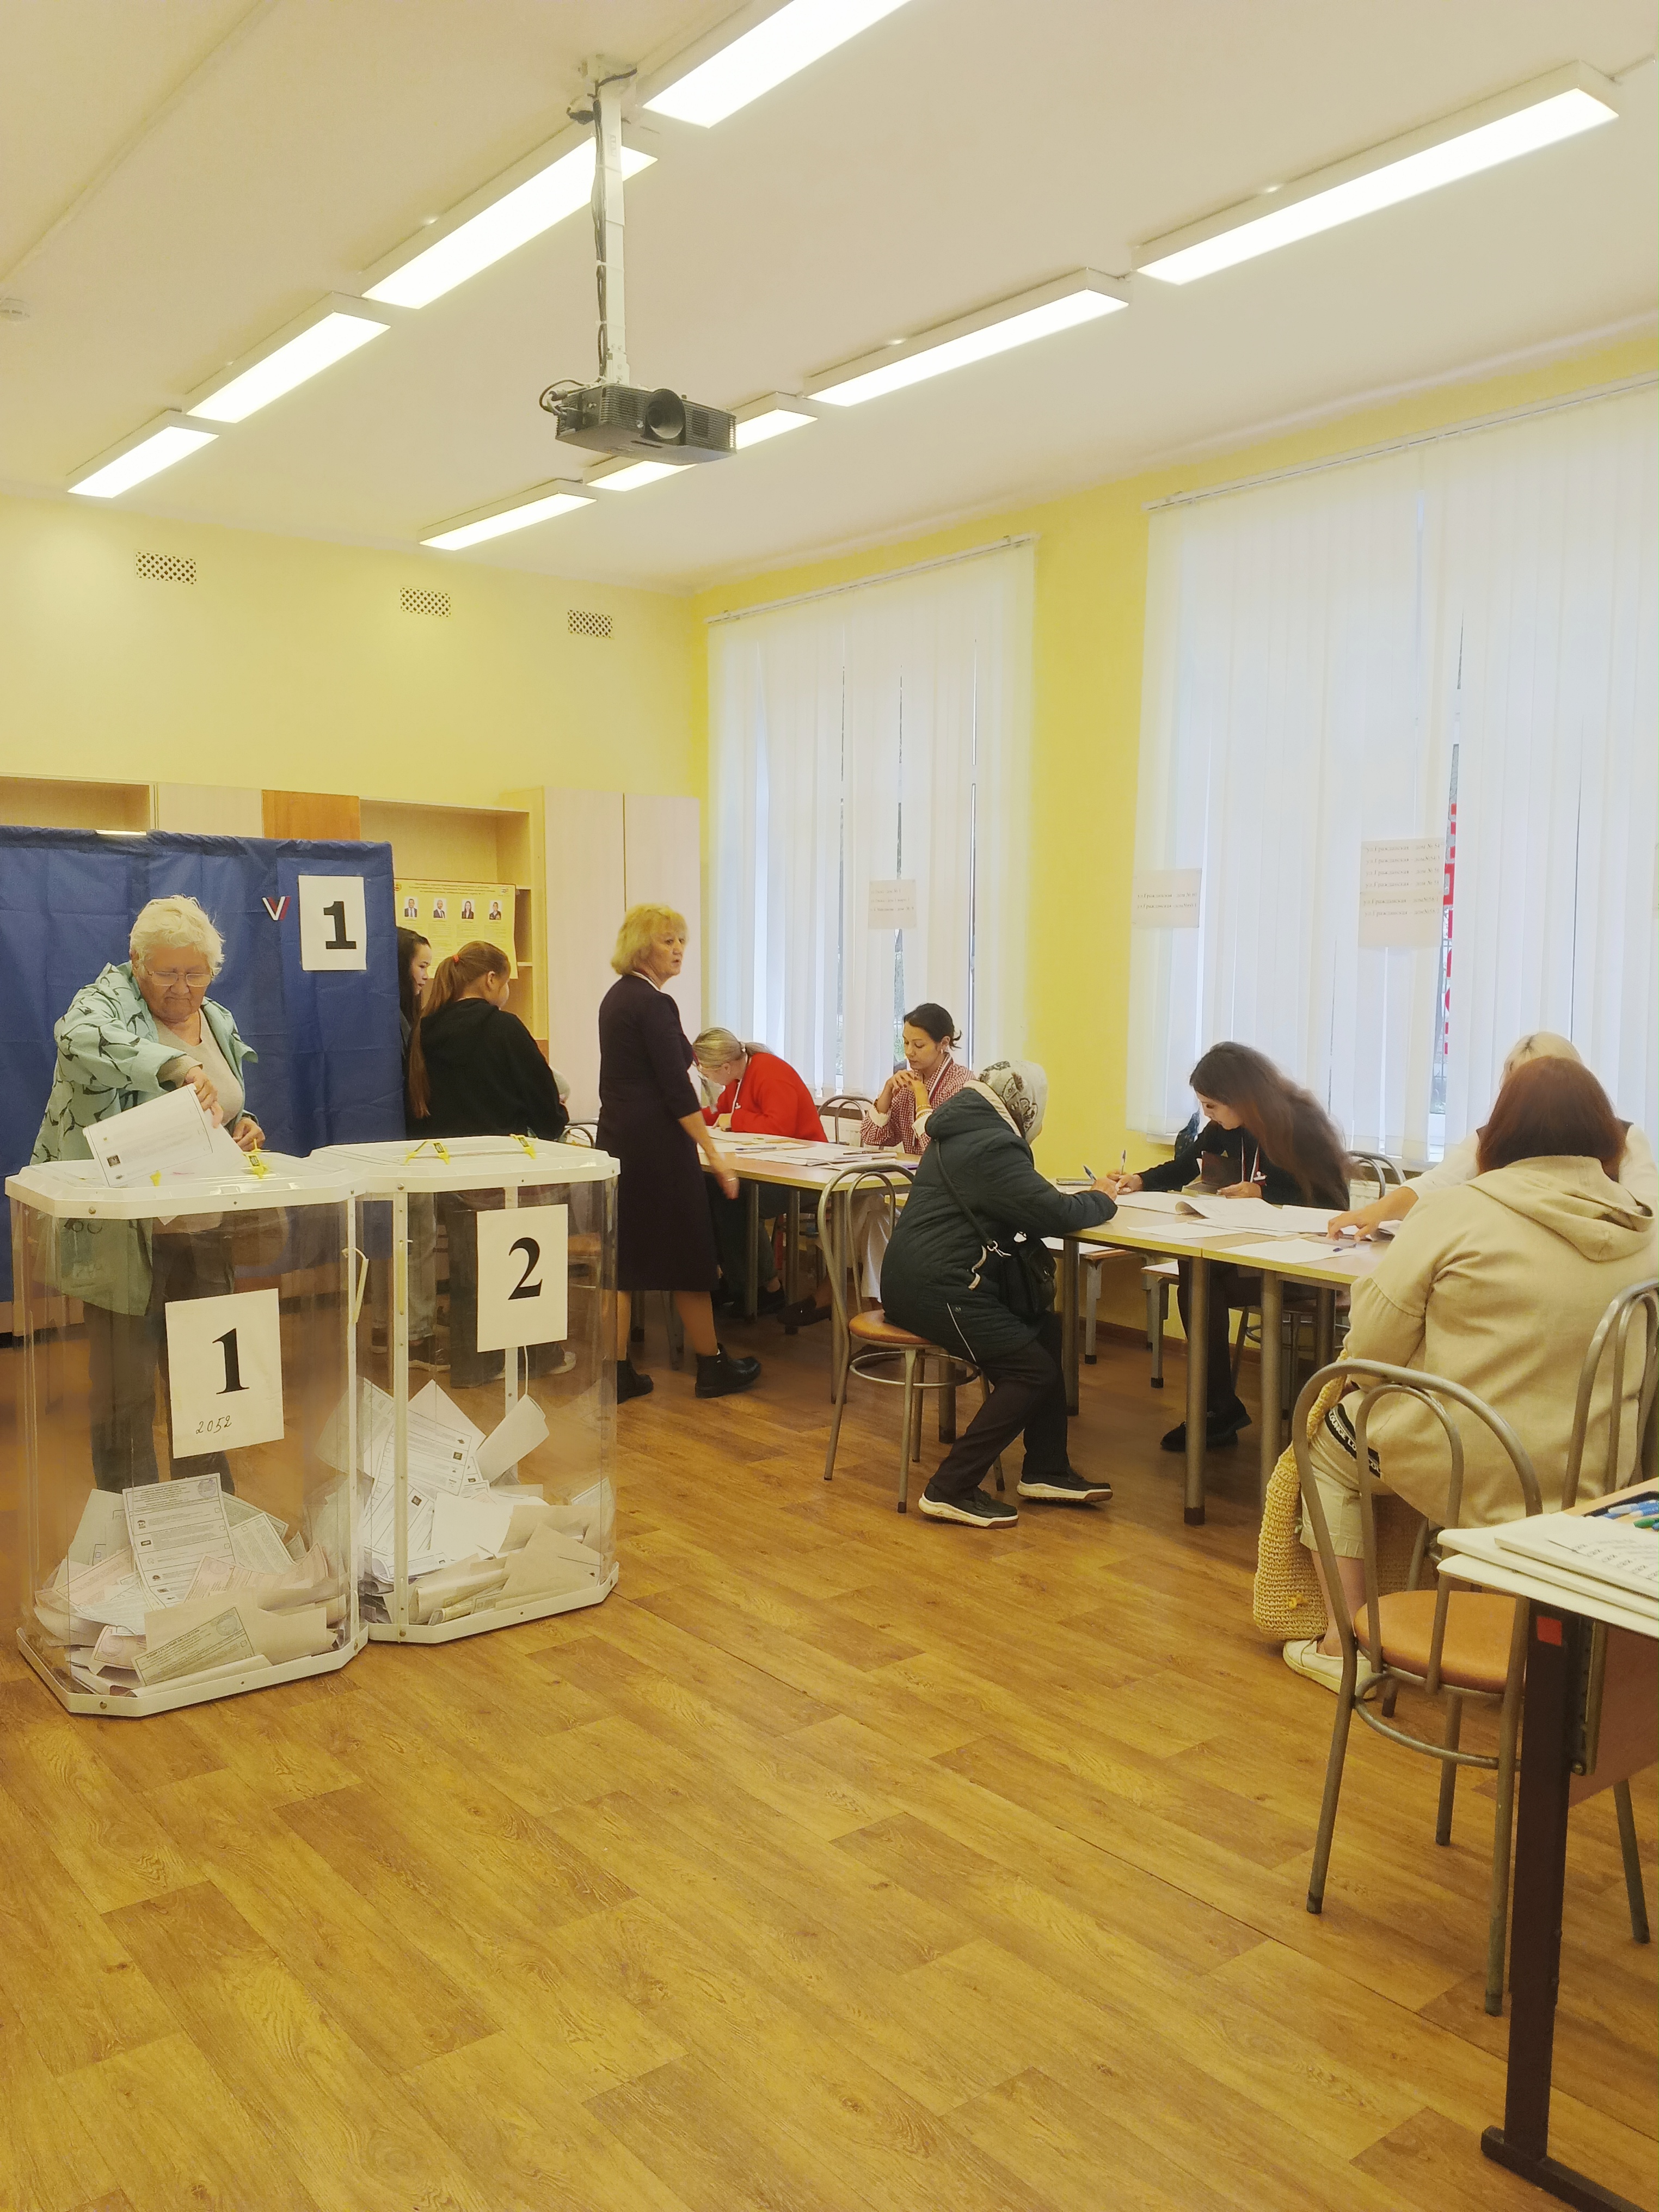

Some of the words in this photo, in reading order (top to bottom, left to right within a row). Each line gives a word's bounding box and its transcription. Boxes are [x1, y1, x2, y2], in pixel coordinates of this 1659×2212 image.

[323, 901, 357, 949] 1
[508, 1237, 543, 1300] 2
[212, 1328, 249, 1394] 1
[195, 1415, 232, 1434] 2052
